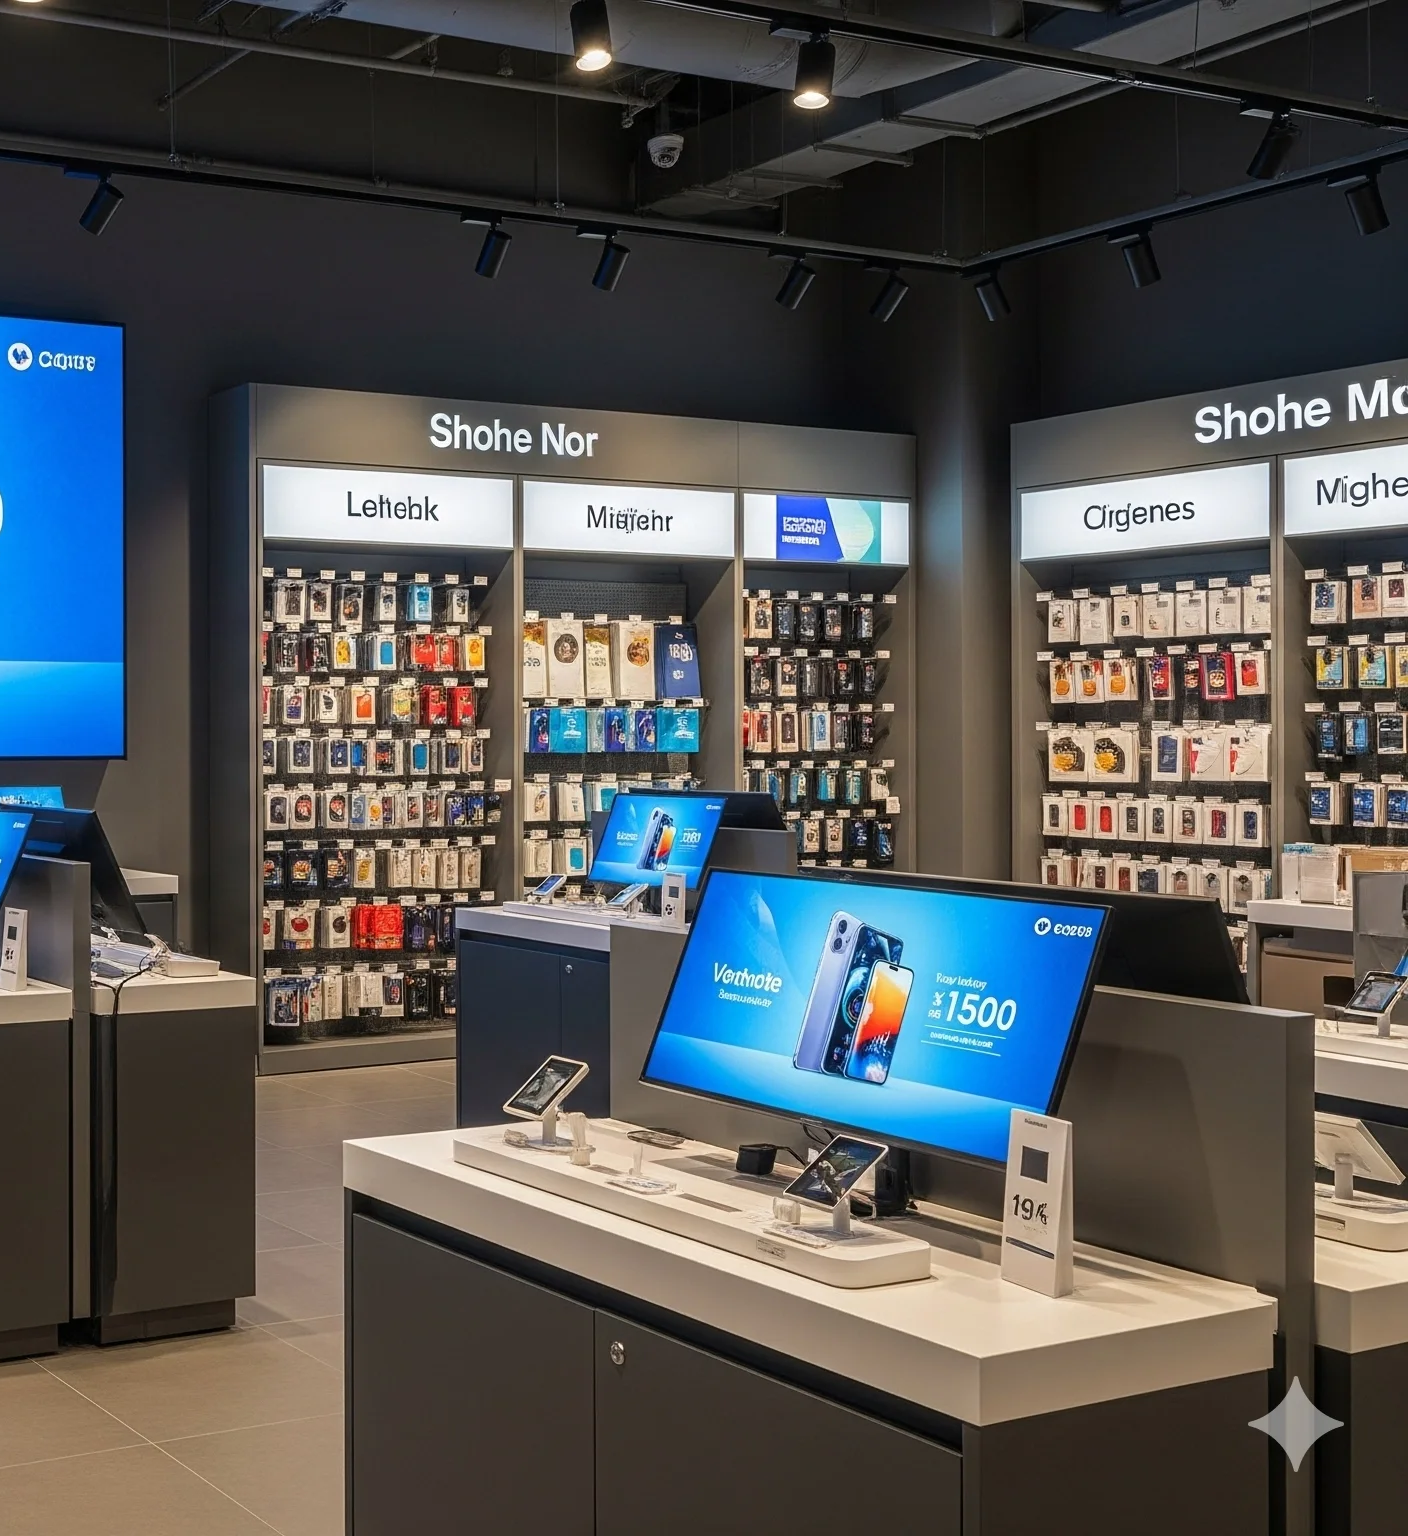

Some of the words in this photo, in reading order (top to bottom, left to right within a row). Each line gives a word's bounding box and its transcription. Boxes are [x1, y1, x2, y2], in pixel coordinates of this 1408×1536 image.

[429, 412, 533, 454] Shohe
[541, 422, 599, 457] Nor
[1194, 392, 1332, 444] Shohe
[946, 990, 1017, 1031] 1500
